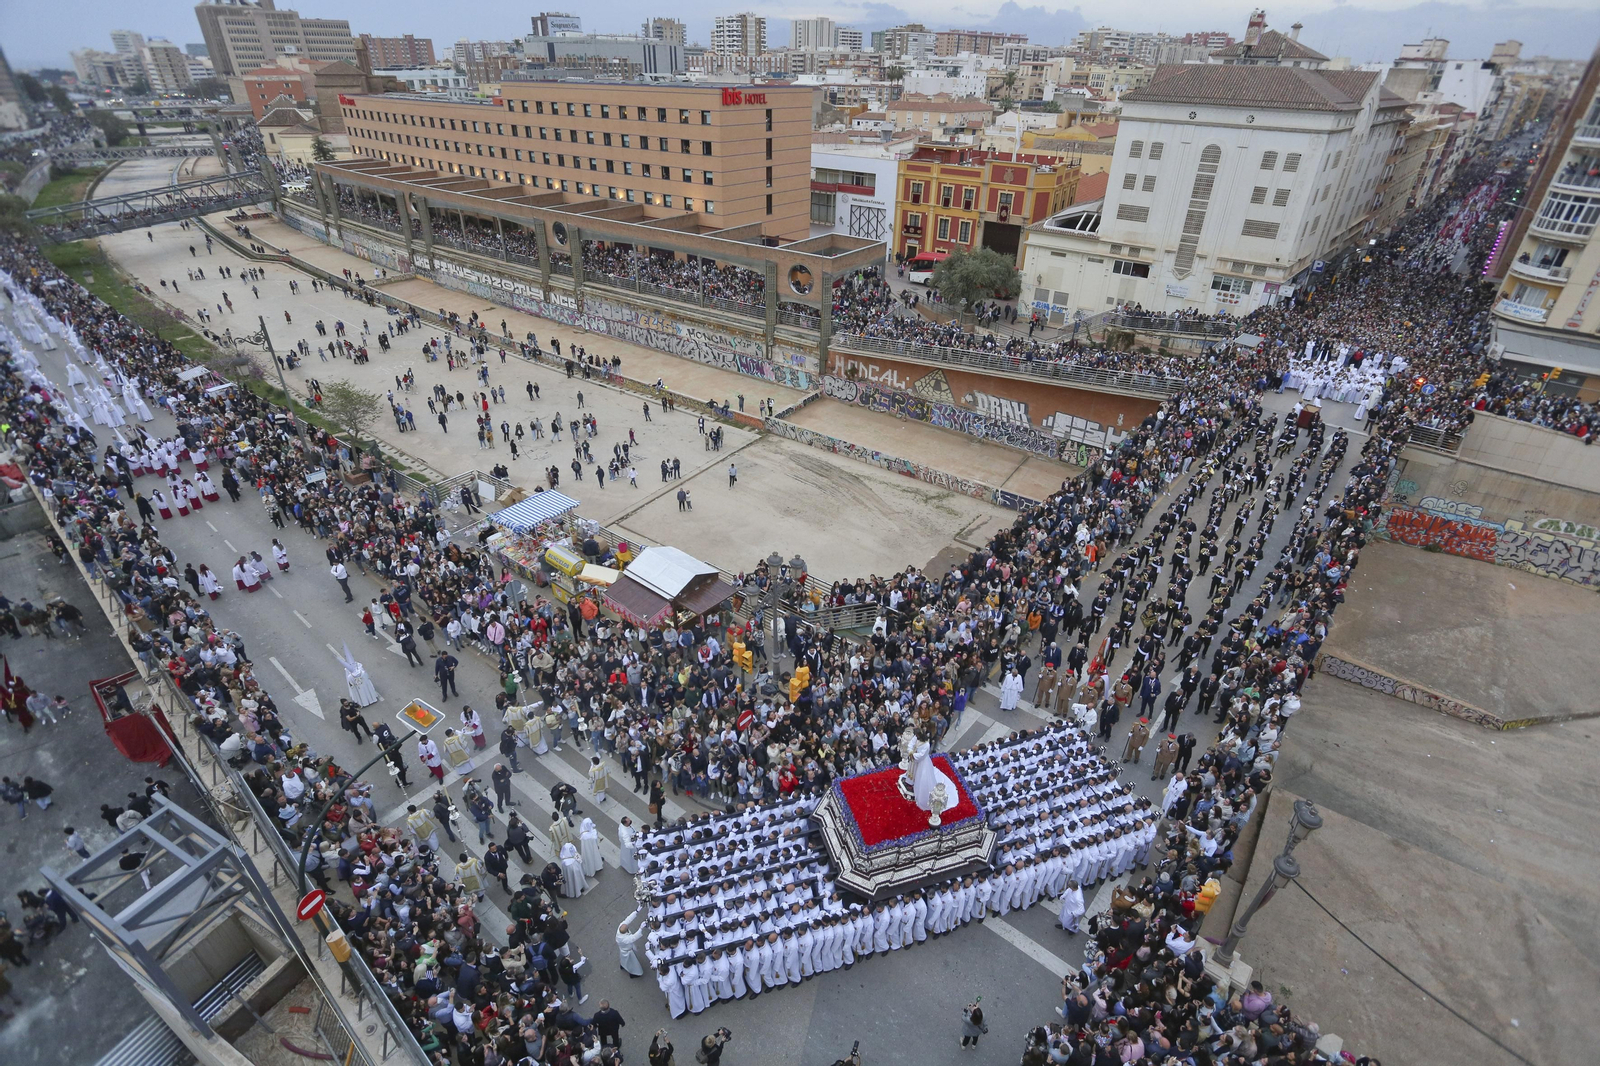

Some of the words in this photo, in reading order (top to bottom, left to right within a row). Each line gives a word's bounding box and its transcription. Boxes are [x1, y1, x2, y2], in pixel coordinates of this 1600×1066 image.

[722, 87, 743, 106] ibis
[745, 93, 768, 105] HOTEL
[1312, 260, 1324, 272] P
